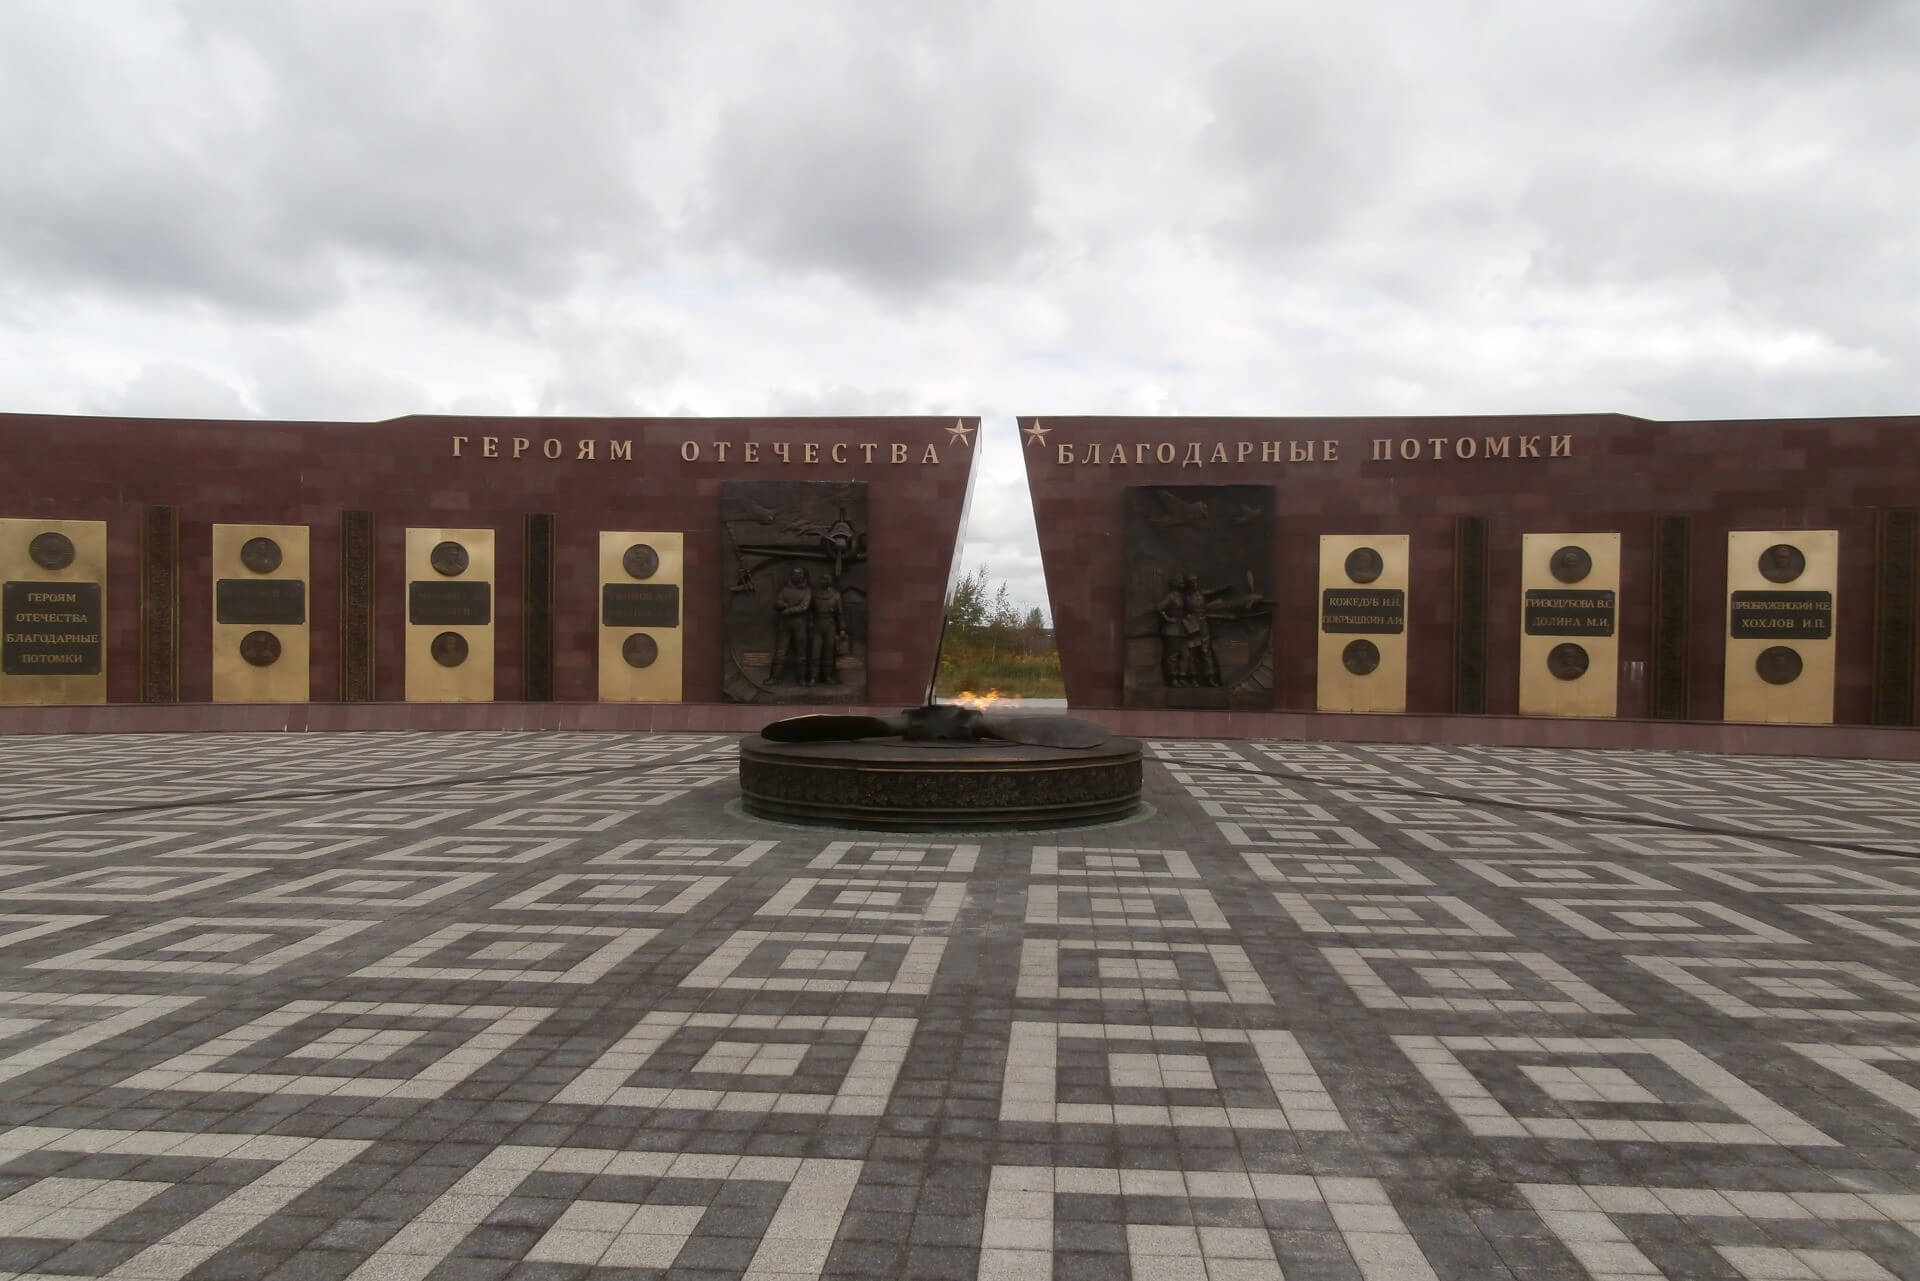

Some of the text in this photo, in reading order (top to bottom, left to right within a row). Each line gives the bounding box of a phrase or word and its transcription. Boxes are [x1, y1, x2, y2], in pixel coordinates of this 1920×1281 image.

[451, 436, 941, 464] ГЕРОЯМ ОТЕЧЕСТВА
[1056, 435, 1573, 468] БЛАГОДАРНЫЕ ПОТОМКИ
[27, 592, 77, 602] ГЕРОЯМ
[1329, 597, 1380, 608] КОЖЕДУБ
[15, 612, 89, 623] ОТЕЧЕСТВА
[1532, 617, 1582, 627] ДОЛИНА
[1741, 618, 1795, 629] ХОХЛОВ
[6, 633, 100, 645] БЛАГОДАРНЫЕ
[22, 654, 83, 664] ПОТОМКИ
